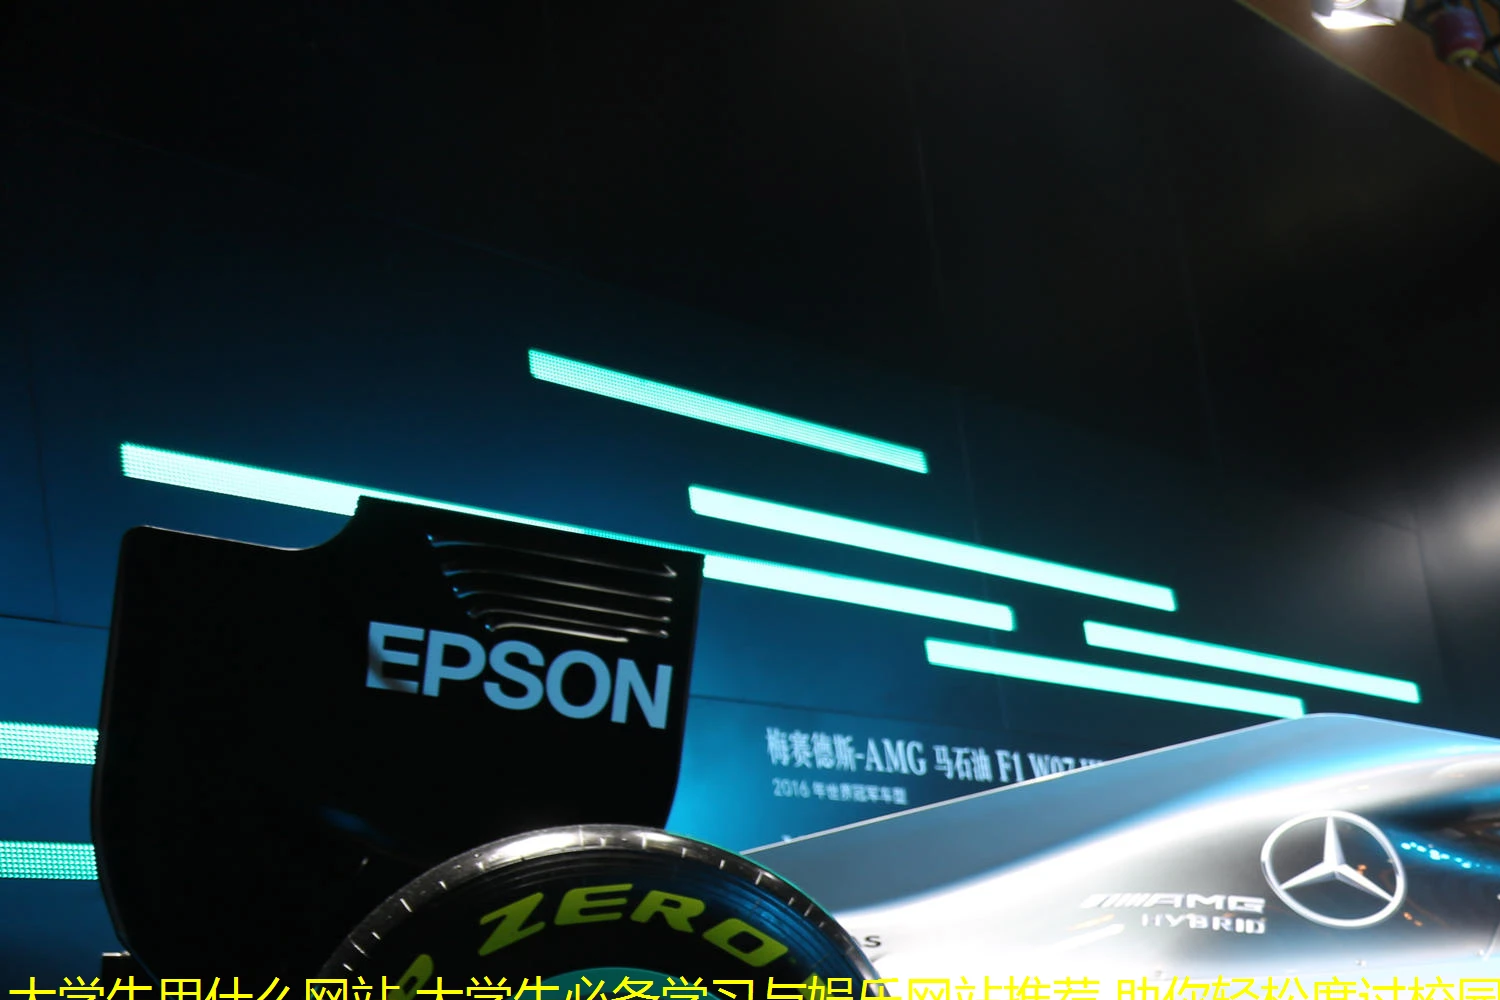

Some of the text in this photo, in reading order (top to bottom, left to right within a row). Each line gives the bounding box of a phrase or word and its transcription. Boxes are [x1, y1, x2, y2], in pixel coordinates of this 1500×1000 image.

[366, 621, 673, 730] EPSON
[766, 726, 928, 776] 梅赛德斯-AMG
[932, 744, 994, 783] 马石油
[995, 749, 1025, 783] F1
[772, 777, 811, 799] 2016
[1141, 912, 1266, 935] HYBRID
[1146, 893, 1266, 914] AMG
[479, 883, 790, 968] ZERO
